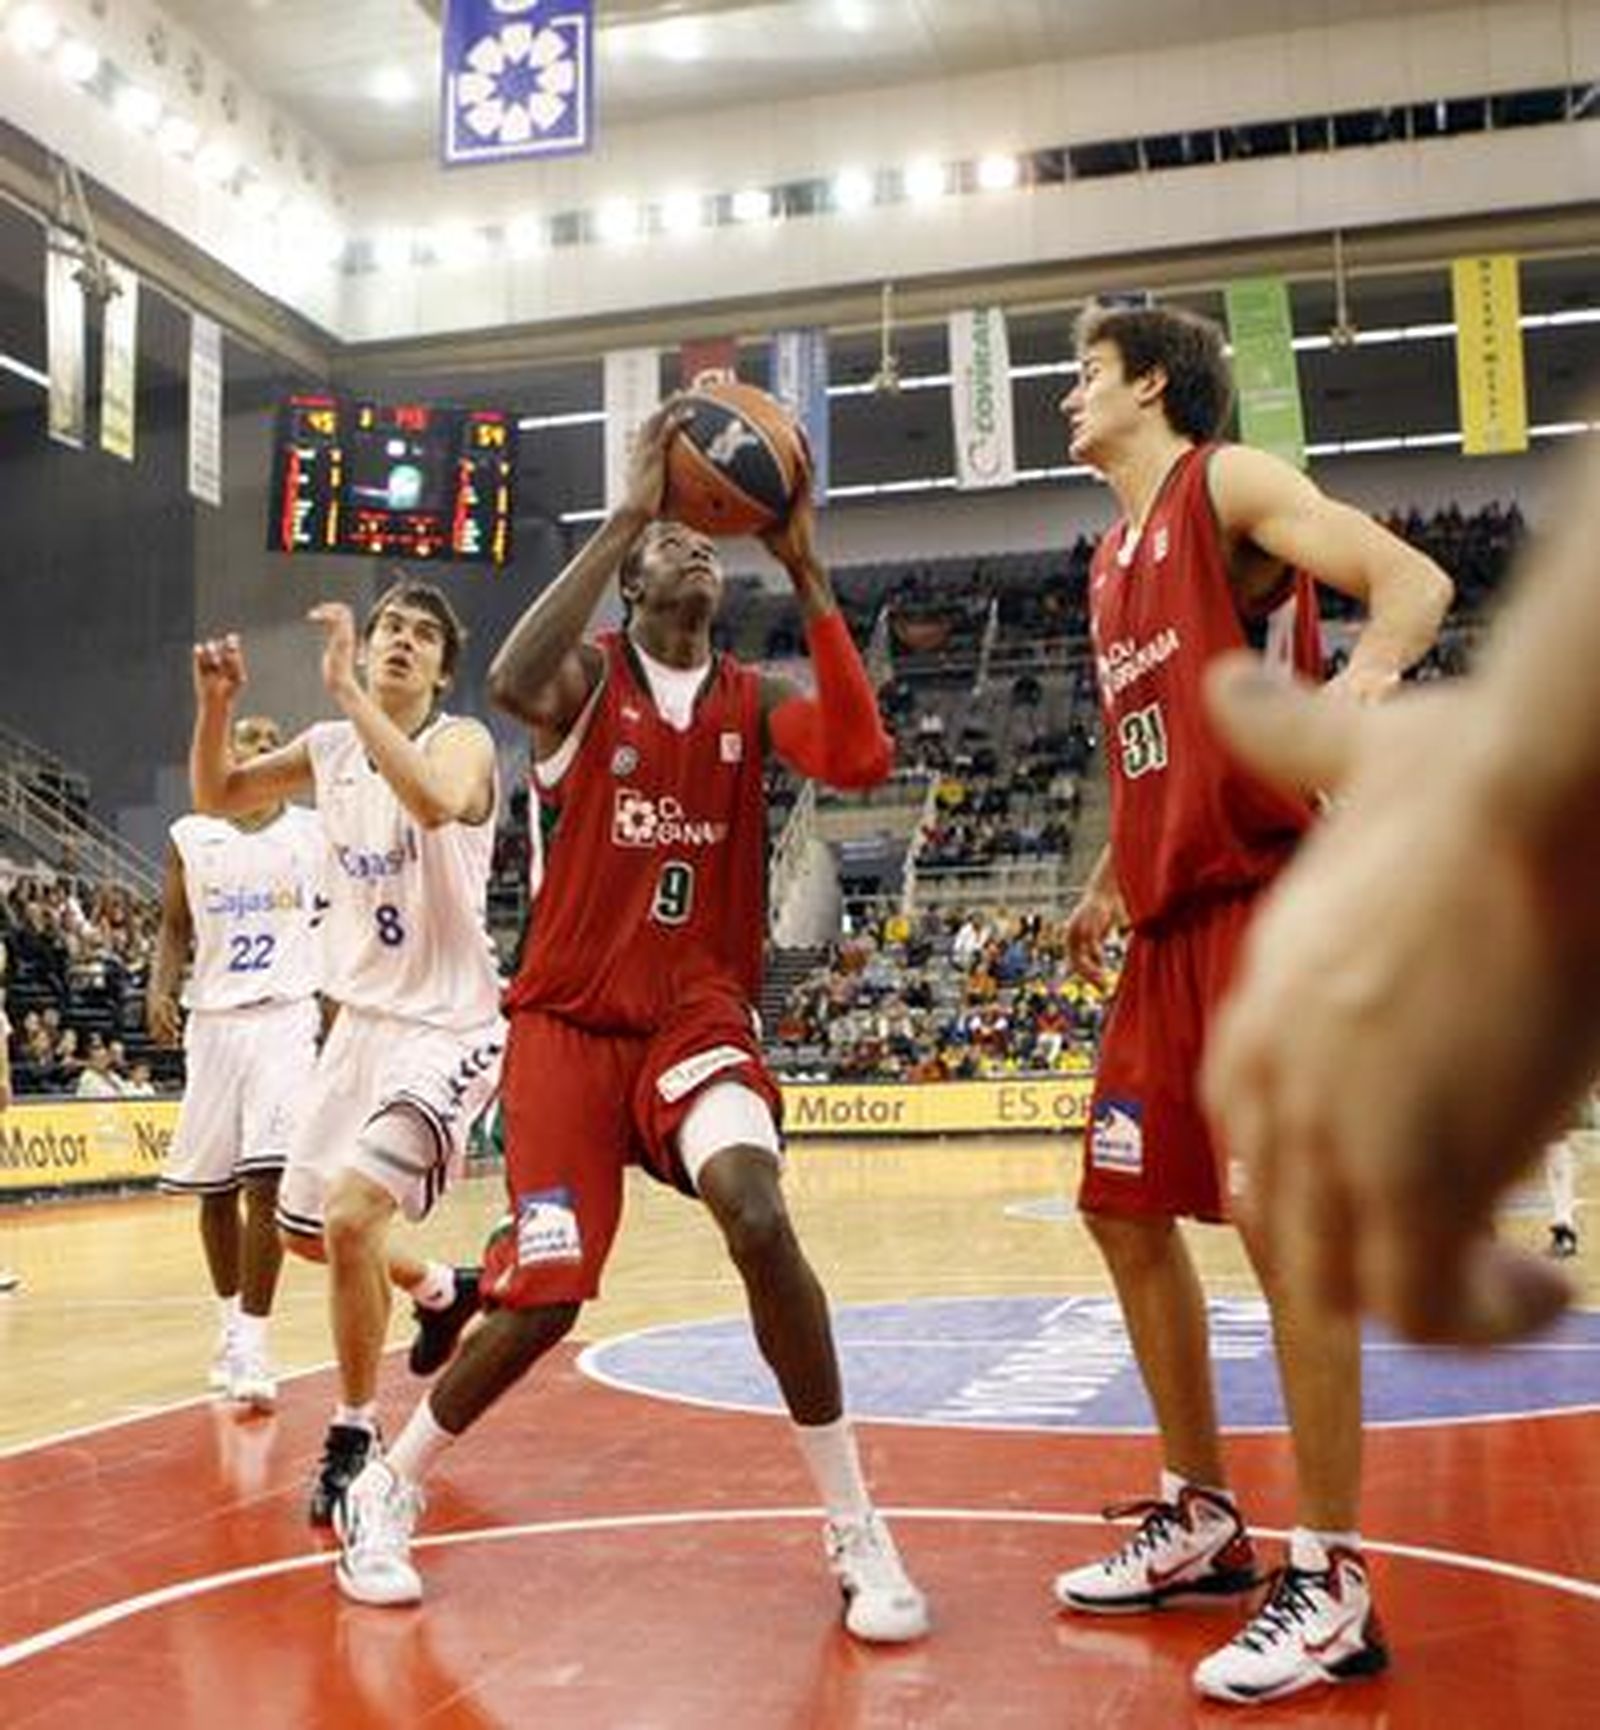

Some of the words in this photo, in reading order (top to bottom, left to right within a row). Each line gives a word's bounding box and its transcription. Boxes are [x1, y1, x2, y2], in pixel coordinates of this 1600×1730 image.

[1119, 703, 1168, 780] 31
[650, 861, 694, 924] 9
[374, 903, 405, 947] 8
[228, 933, 276, 972] 22
[793, 1095, 905, 1125] Motor
[997, 1086, 1041, 1122] ES
[0, 1124, 89, 1169] Motor
